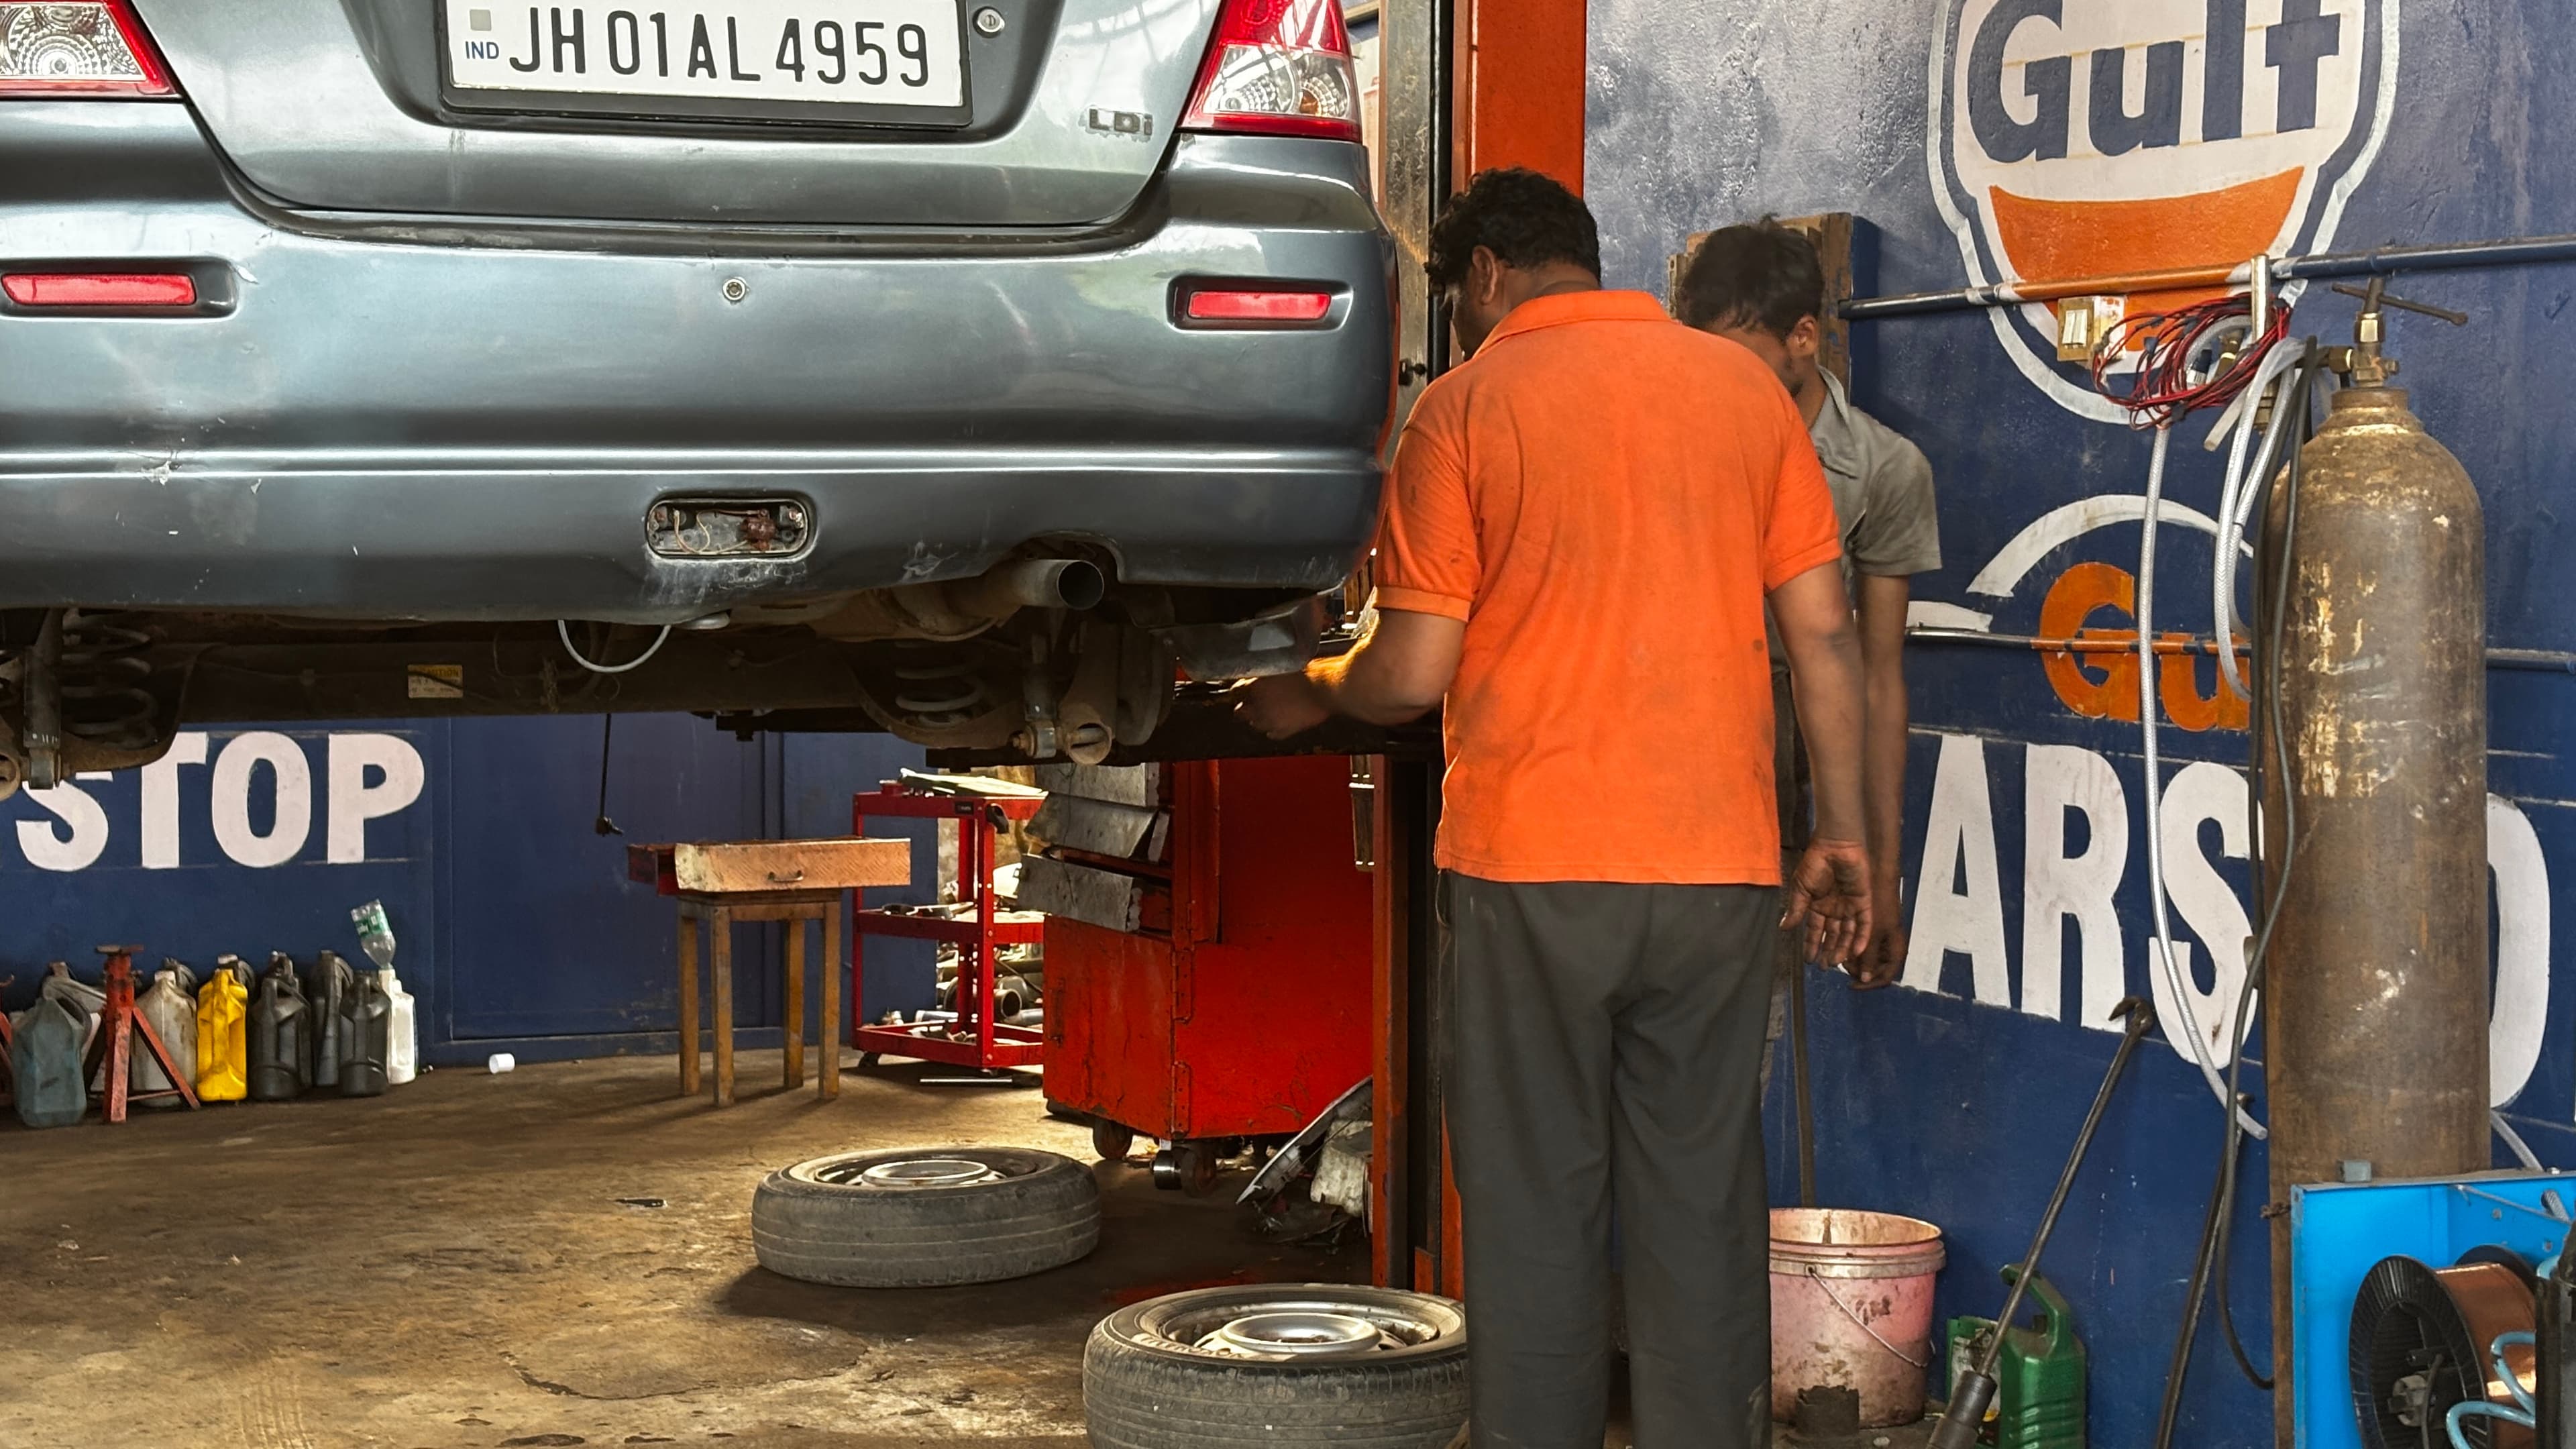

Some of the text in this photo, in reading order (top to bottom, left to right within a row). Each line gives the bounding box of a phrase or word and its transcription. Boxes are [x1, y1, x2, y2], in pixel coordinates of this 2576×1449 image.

[466, 41, 499, 59] IND
[1967, 0, 2341, 163] Gulf
[2040, 561, 2250, 732] Gu
[15, 731, 425, 871] STOP
